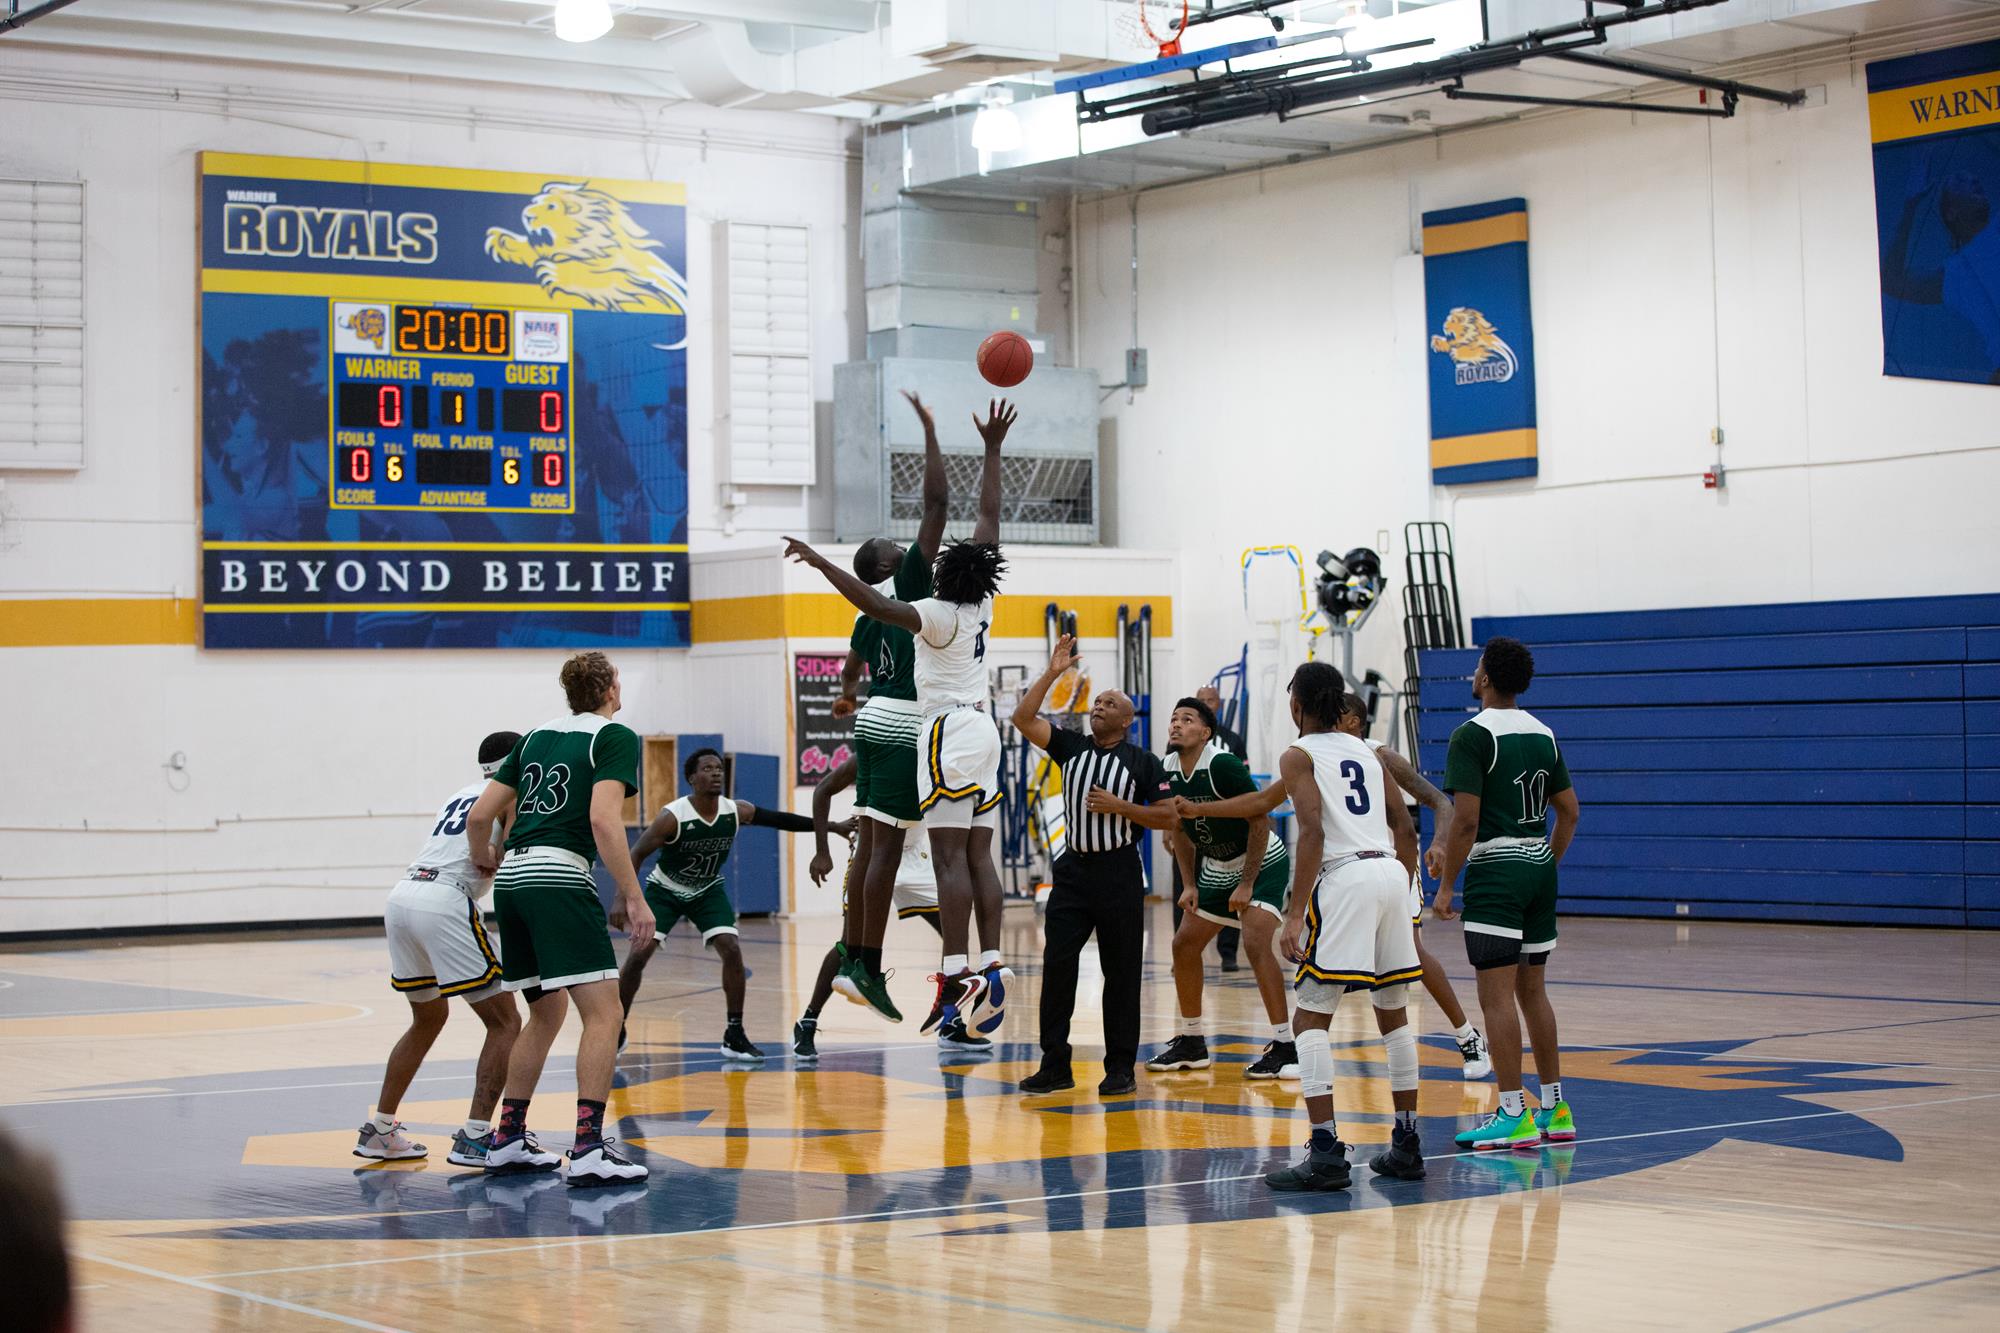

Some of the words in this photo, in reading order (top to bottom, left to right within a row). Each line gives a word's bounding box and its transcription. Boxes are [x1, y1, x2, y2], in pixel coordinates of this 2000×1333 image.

[226, 190, 277, 203] WARNER
[224, 202, 437, 264] ROYALS
[399, 308, 506, 354] 20:00
[522, 318, 559, 337] NAIA
[345, 357, 421, 380] WARNER
[432, 371, 475, 388] PERIOD
[505, 363, 560, 386] GUEST
[1455, 361, 1507, 385] ROYALS
[379, 385, 401, 427] 0
[455, 394, 463, 424] 1
[540, 391, 561, 432] 0
[336, 431, 376, 447] FOULS
[412, 433, 443, 448] FOUL
[450, 435, 494, 450] PLAYER
[529, 437, 567, 452] FOULS
[351, 448, 370, 482] 0
[386, 455, 403, 482] 6
[503, 459, 519, 485] 6
[543, 453, 562, 486] 0
[336, 488, 376, 504] SCORE
[419, 490, 487, 506] ADVANTAGE
[529, 492, 568, 508] SCORE
[220, 560, 452, 593] BEYOND
[483, 560, 675, 593] BELIEF
[973, 620, 989, 664] 4
[517, 763, 571, 816] 23
[1339, 759, 1371, 816] 3
[1513, 769, 1550, 825] 10
[432, 795, 480, 837] 13
[1194, 814, 1213, 845] 5
[680, 837, 733, 853] WEBBER
[679, 853, 720, 878] 21
